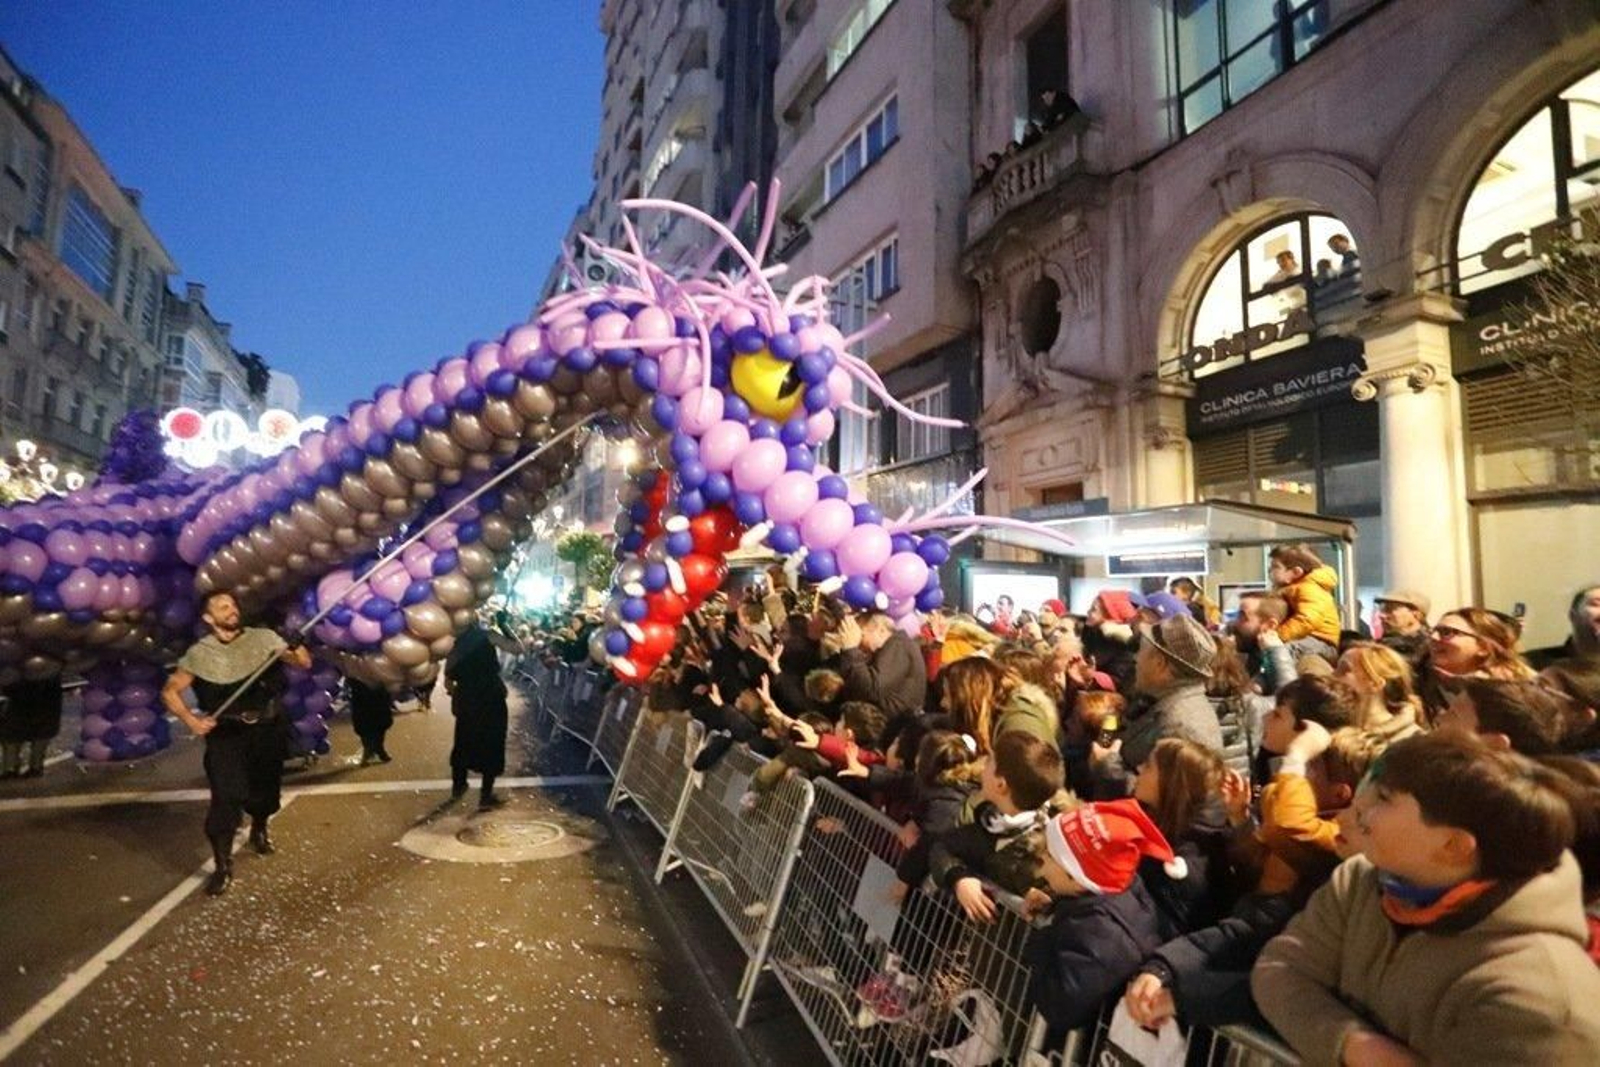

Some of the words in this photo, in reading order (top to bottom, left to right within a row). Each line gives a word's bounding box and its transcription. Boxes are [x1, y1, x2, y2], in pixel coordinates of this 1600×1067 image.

[1180, 306, 1314, 370] ONDA
[1200, 387, 1269, 414] CLINICA
[1273, 362, 1362, 396] BAVIERA
